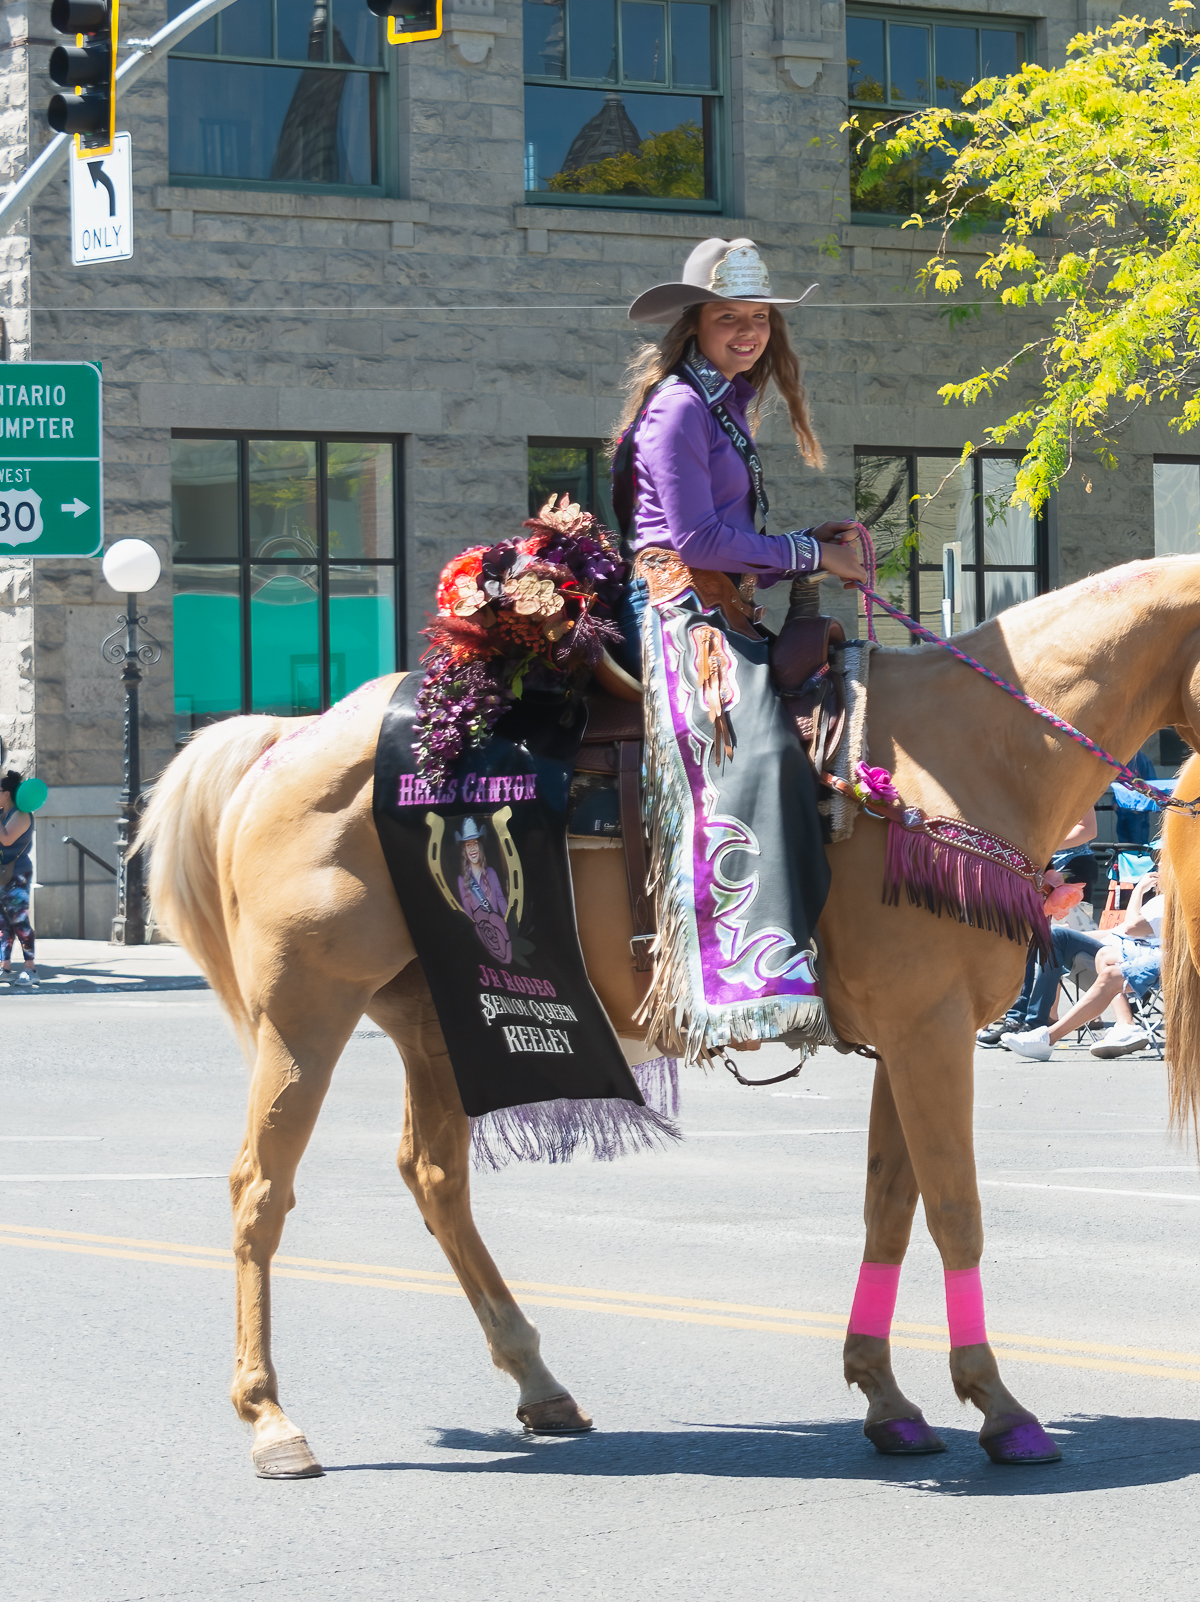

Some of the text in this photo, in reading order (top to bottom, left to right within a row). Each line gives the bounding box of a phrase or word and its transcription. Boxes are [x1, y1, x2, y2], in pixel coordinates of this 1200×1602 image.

[82, 225, 122, 251] ONLY
[461, 772, 538, 803] CANYON
[479, 964, 557, 998] JR RODEO
[479, 993, 579, 1026] SENIOR QUEEN
[501, 1025, 575, 1054] KEELEY
